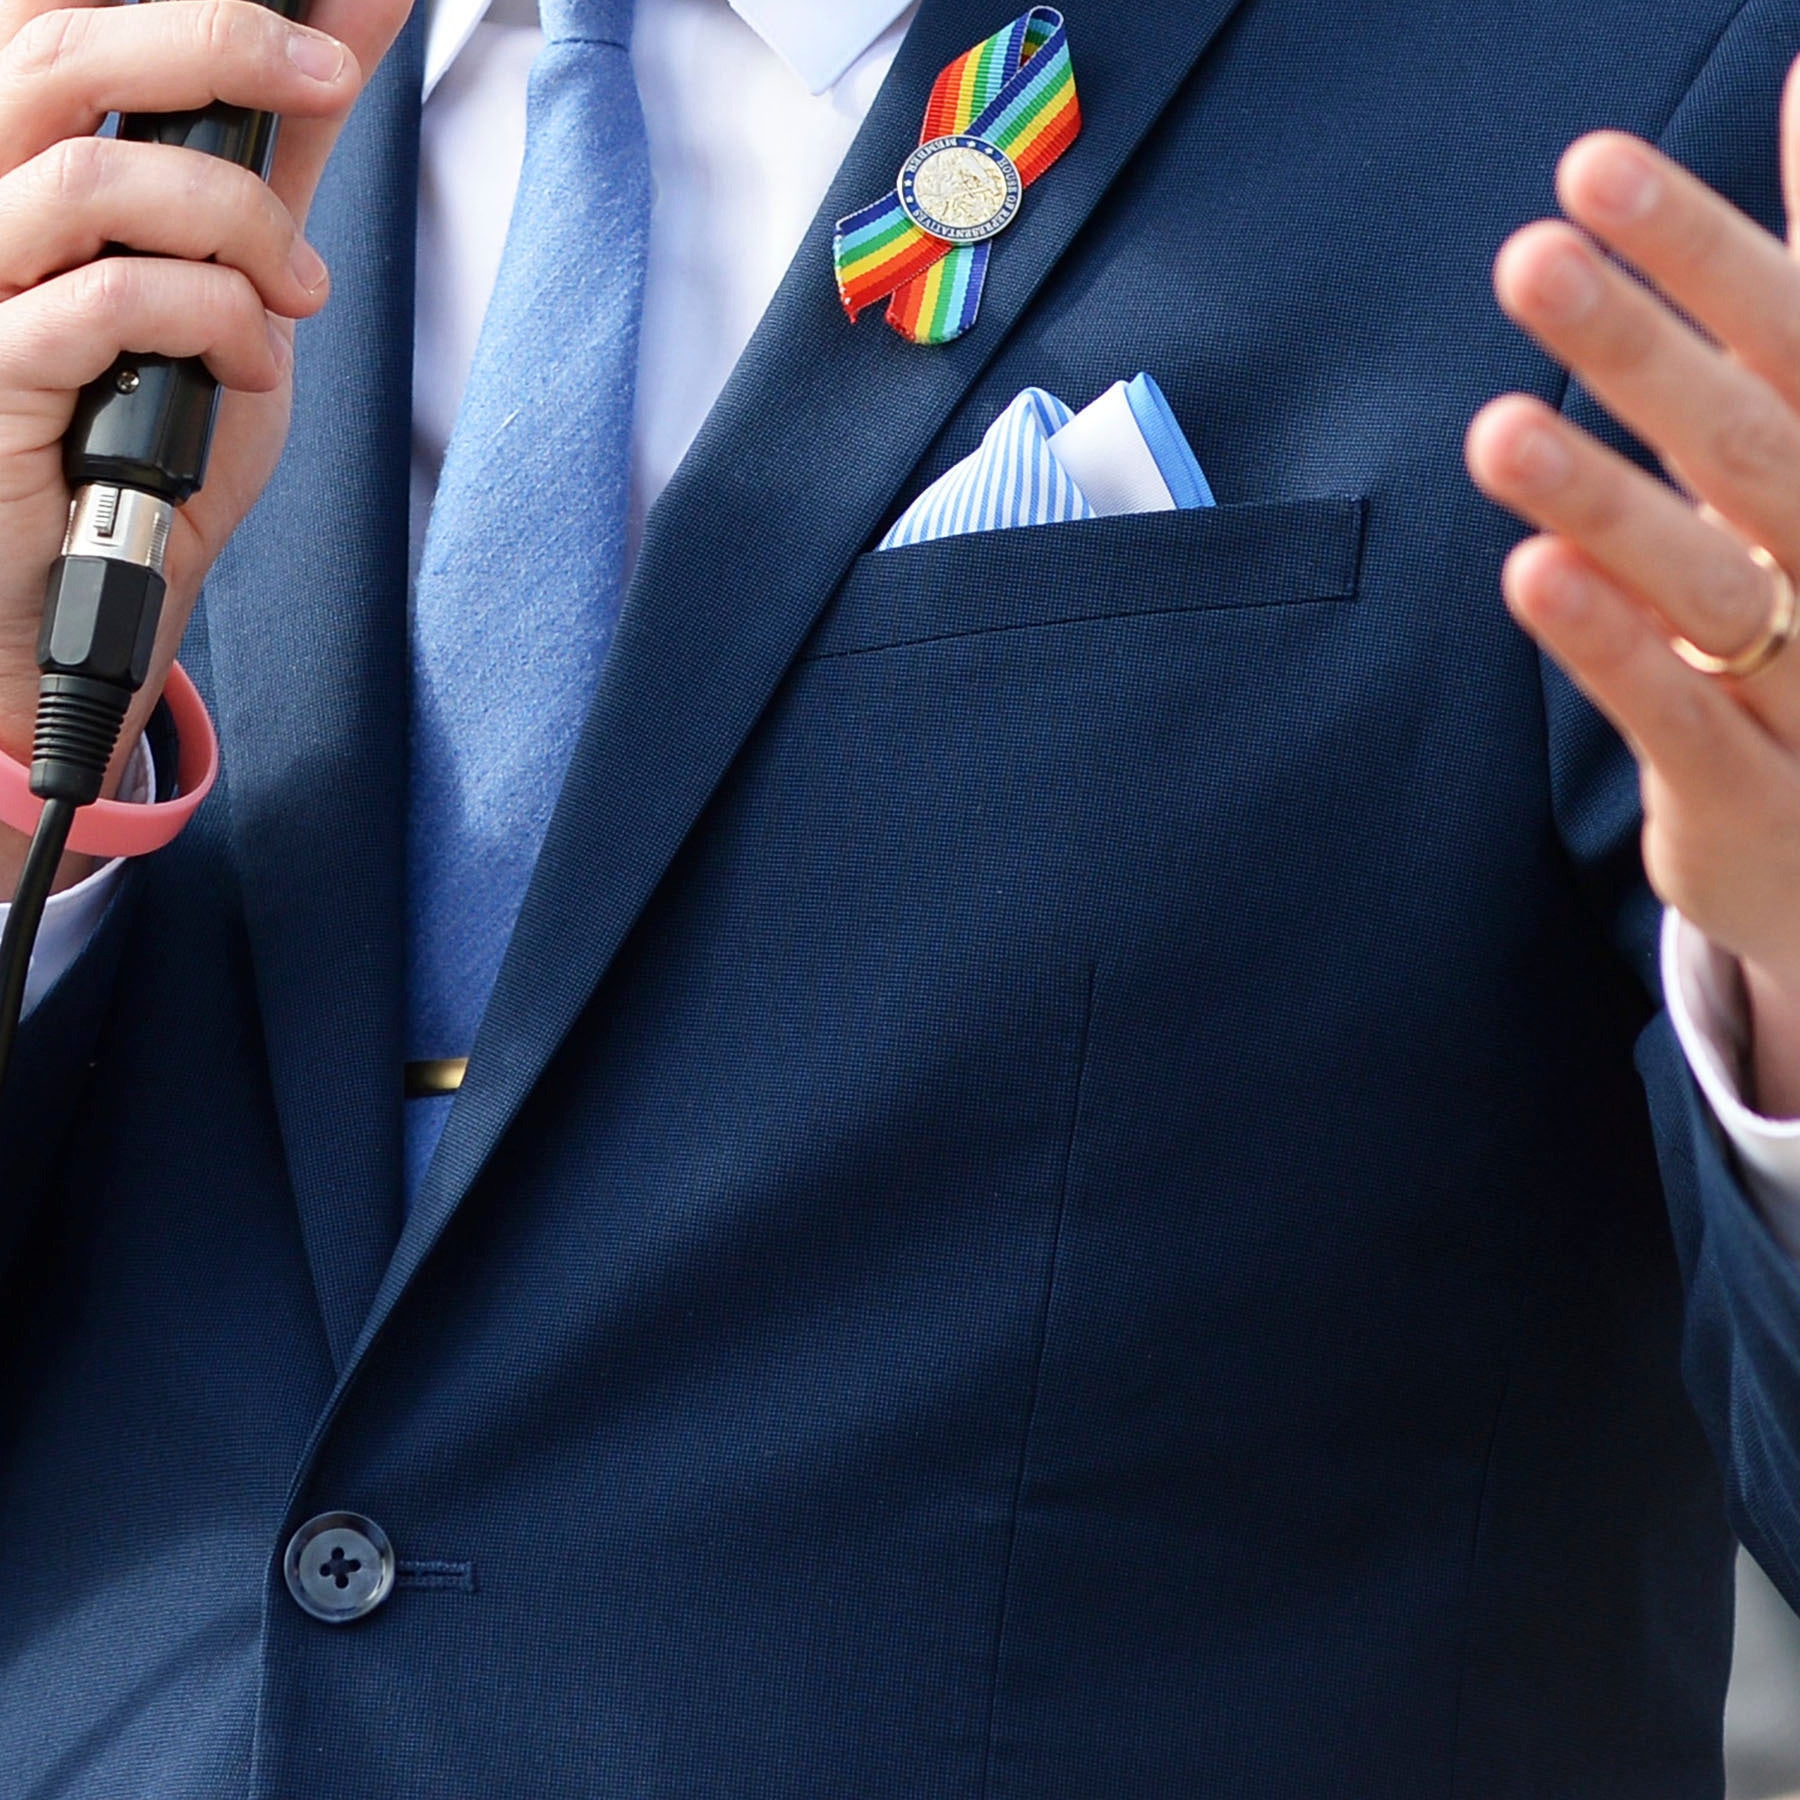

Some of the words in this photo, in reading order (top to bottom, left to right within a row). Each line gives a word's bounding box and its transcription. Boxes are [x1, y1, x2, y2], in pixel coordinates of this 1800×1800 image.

[906, 138, 958, 173] MEMBER
[997, 157, 1017, 193] HOUSE
[1006, 195, 1017, 210] OF
[912, 209, 1011, 238] REPRESENTATIVES
